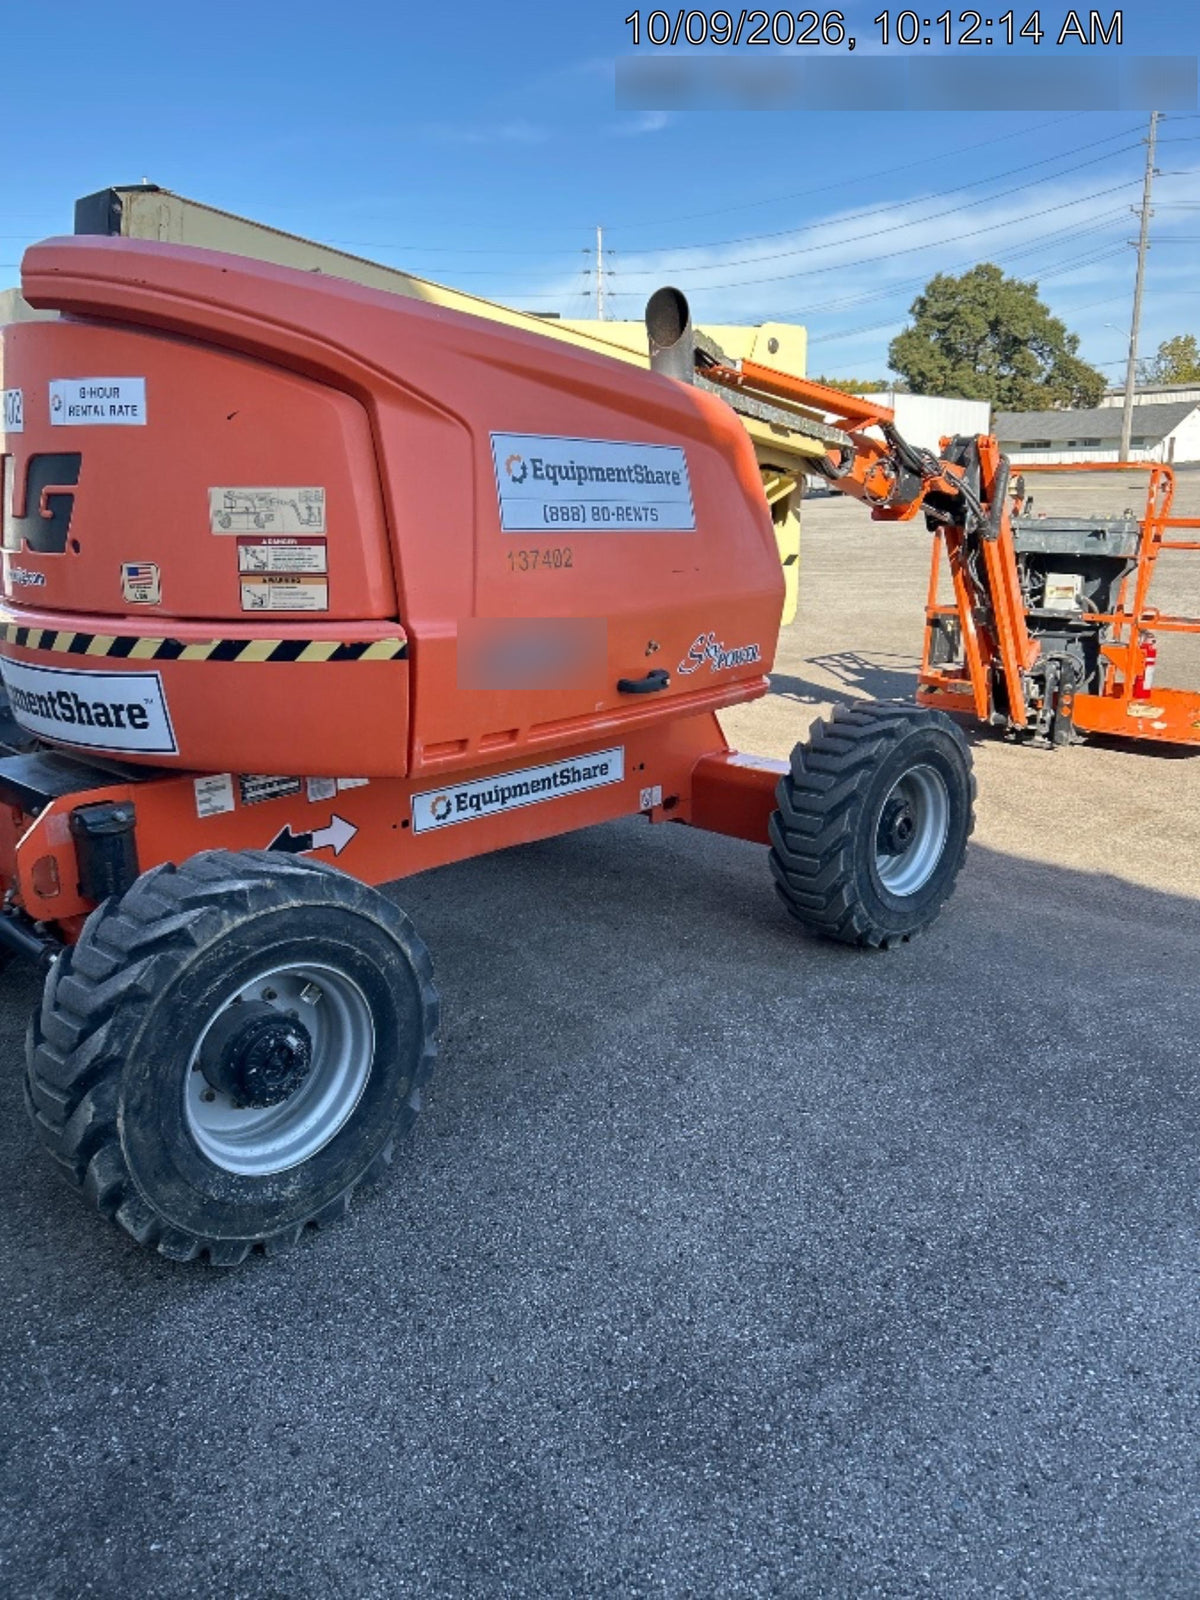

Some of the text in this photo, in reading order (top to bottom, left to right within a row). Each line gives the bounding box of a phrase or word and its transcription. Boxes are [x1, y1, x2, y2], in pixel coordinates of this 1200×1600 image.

[79, 386, 120, 399] 8-HOUR
[68, 404, 138, 417] RENTAL RATE
[530, 457, 682, 487] EquipmentShare
[543, 504, 659, 524] (888) 80-RENTS
[507, 547, 574, 572] 137402
[454, 761, 610, 814] EquipmentShare
